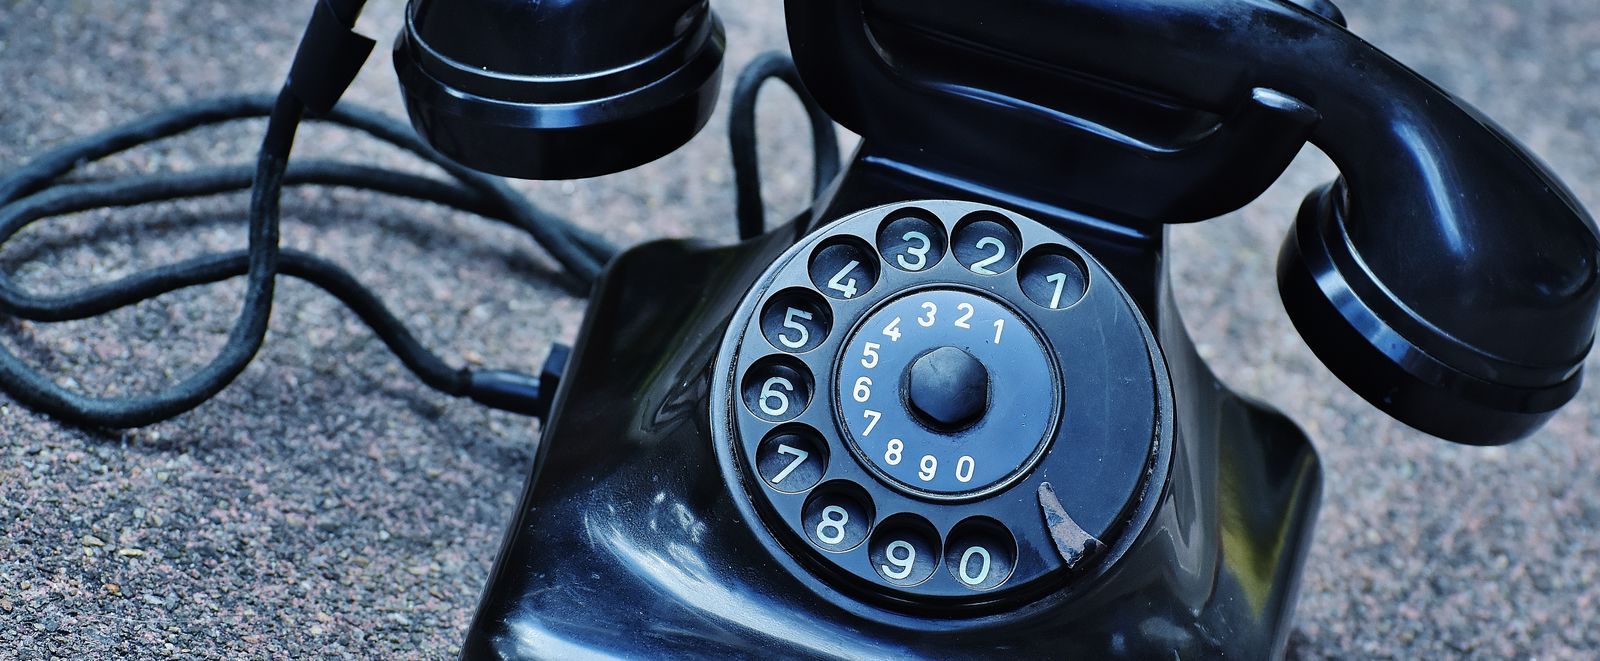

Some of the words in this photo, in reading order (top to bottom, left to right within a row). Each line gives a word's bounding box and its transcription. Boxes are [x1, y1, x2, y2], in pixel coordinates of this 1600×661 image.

[897, 231, 931, 271] 3
[970, 236, 1005, 275] 2
[827, 260, 858, 298] 4
[1045, 272, 1068, 309] 1
[778, 306, 813, 348] 5
[883, 317, 902, 341] 4
[918, 302, 937, 326] 3
[955, 303, 973, 328] 2
[993, 319, 1005, 343] 1
[861, 342, 881, 368] 5
[759, 376, 793, 416] 6
[852, 377, 871, 401] 6
[863, 410, 882, 436] 7
[771, 445, 808, 484] 7
[884, 439, 904, 465] 8
[918, 455, 938, 481] 9
[955, 455, 975, 482] 0
[816, 505, 849, 545] 8
[882, 540, 916, 579] 9
[959, 546, 991, 585] 0
